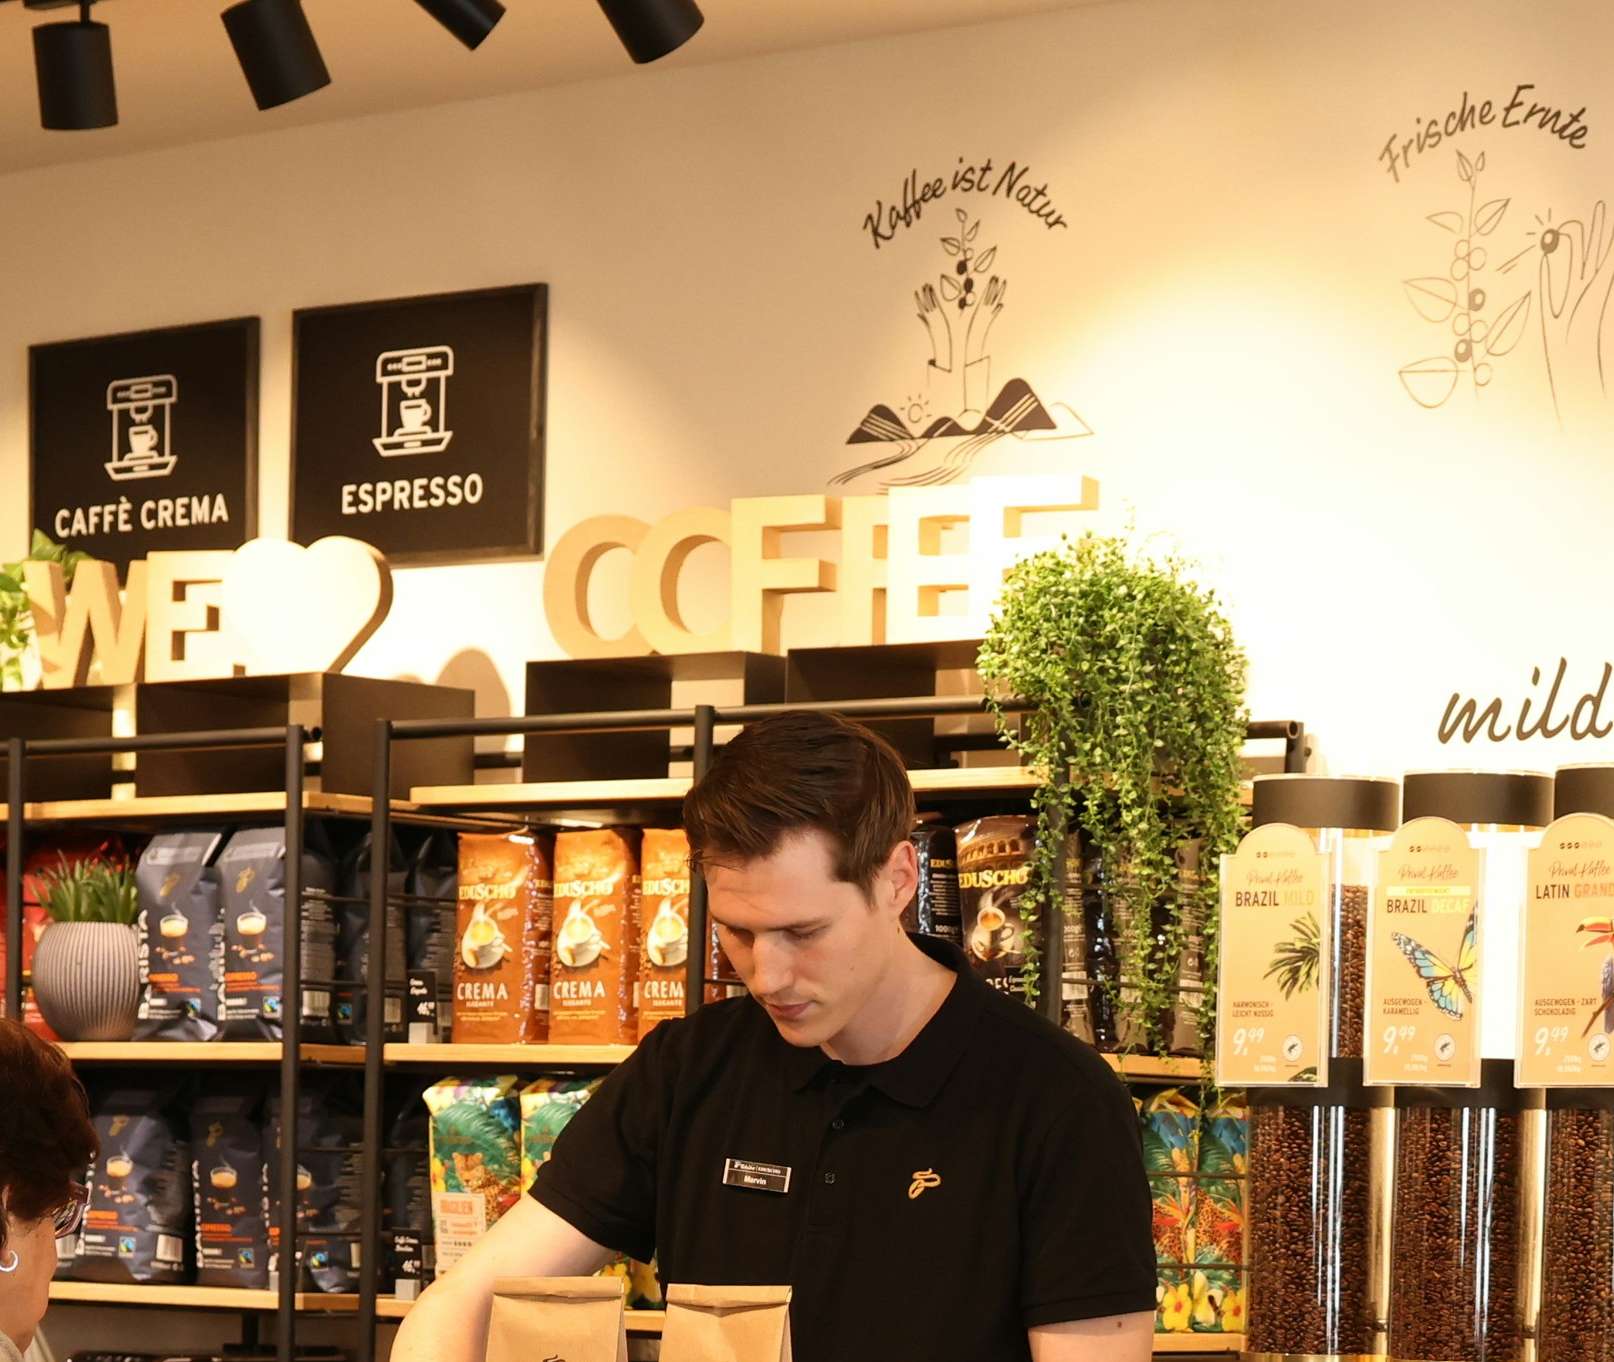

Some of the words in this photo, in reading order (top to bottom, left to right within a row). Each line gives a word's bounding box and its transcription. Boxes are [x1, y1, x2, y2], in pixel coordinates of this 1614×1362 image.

[1379, 91, 1497, 183] Frische
[1502, 84, 1588, 150] Ernte
[862, 168, 946, 249] Kaffee
[951, 156, 993, 193] ist
[992, 161, 1068, 230] Natur
[341, 474, 483, 515] ESPRESSO
[54, 496, 132, 539] CAFFÈ
[140, 494, 229, 531] CREMA
[24, 550, 237, 689] WE
[542, 474, 1101, 662] COFFEE
[1438, 657, 1613, 744] mild
[459, 883, 517, 900] EDUSCHO
[959, 868, 1030, 888] EDUSCHO
[1535, 884, 1570, 900] LATIN
[1235, 891, 1279, 907] BRAZIL
[1284, 891, 1315, 906] MILD
[1387, 899, 1427, 914] BRAZIL
[1430, 898, 1469, 914] DECAF
[457, 982, 508, 1000] CREMA
[553, 980, 605, 999] CREMA
[1233, 1028, 1265, 1056] 9,49
[1382, 1026, 1416, 1055] 9,49
[1534, 1026, 1569, 1056] 9,49
[744, 1175, 767, 1186] Marvin
